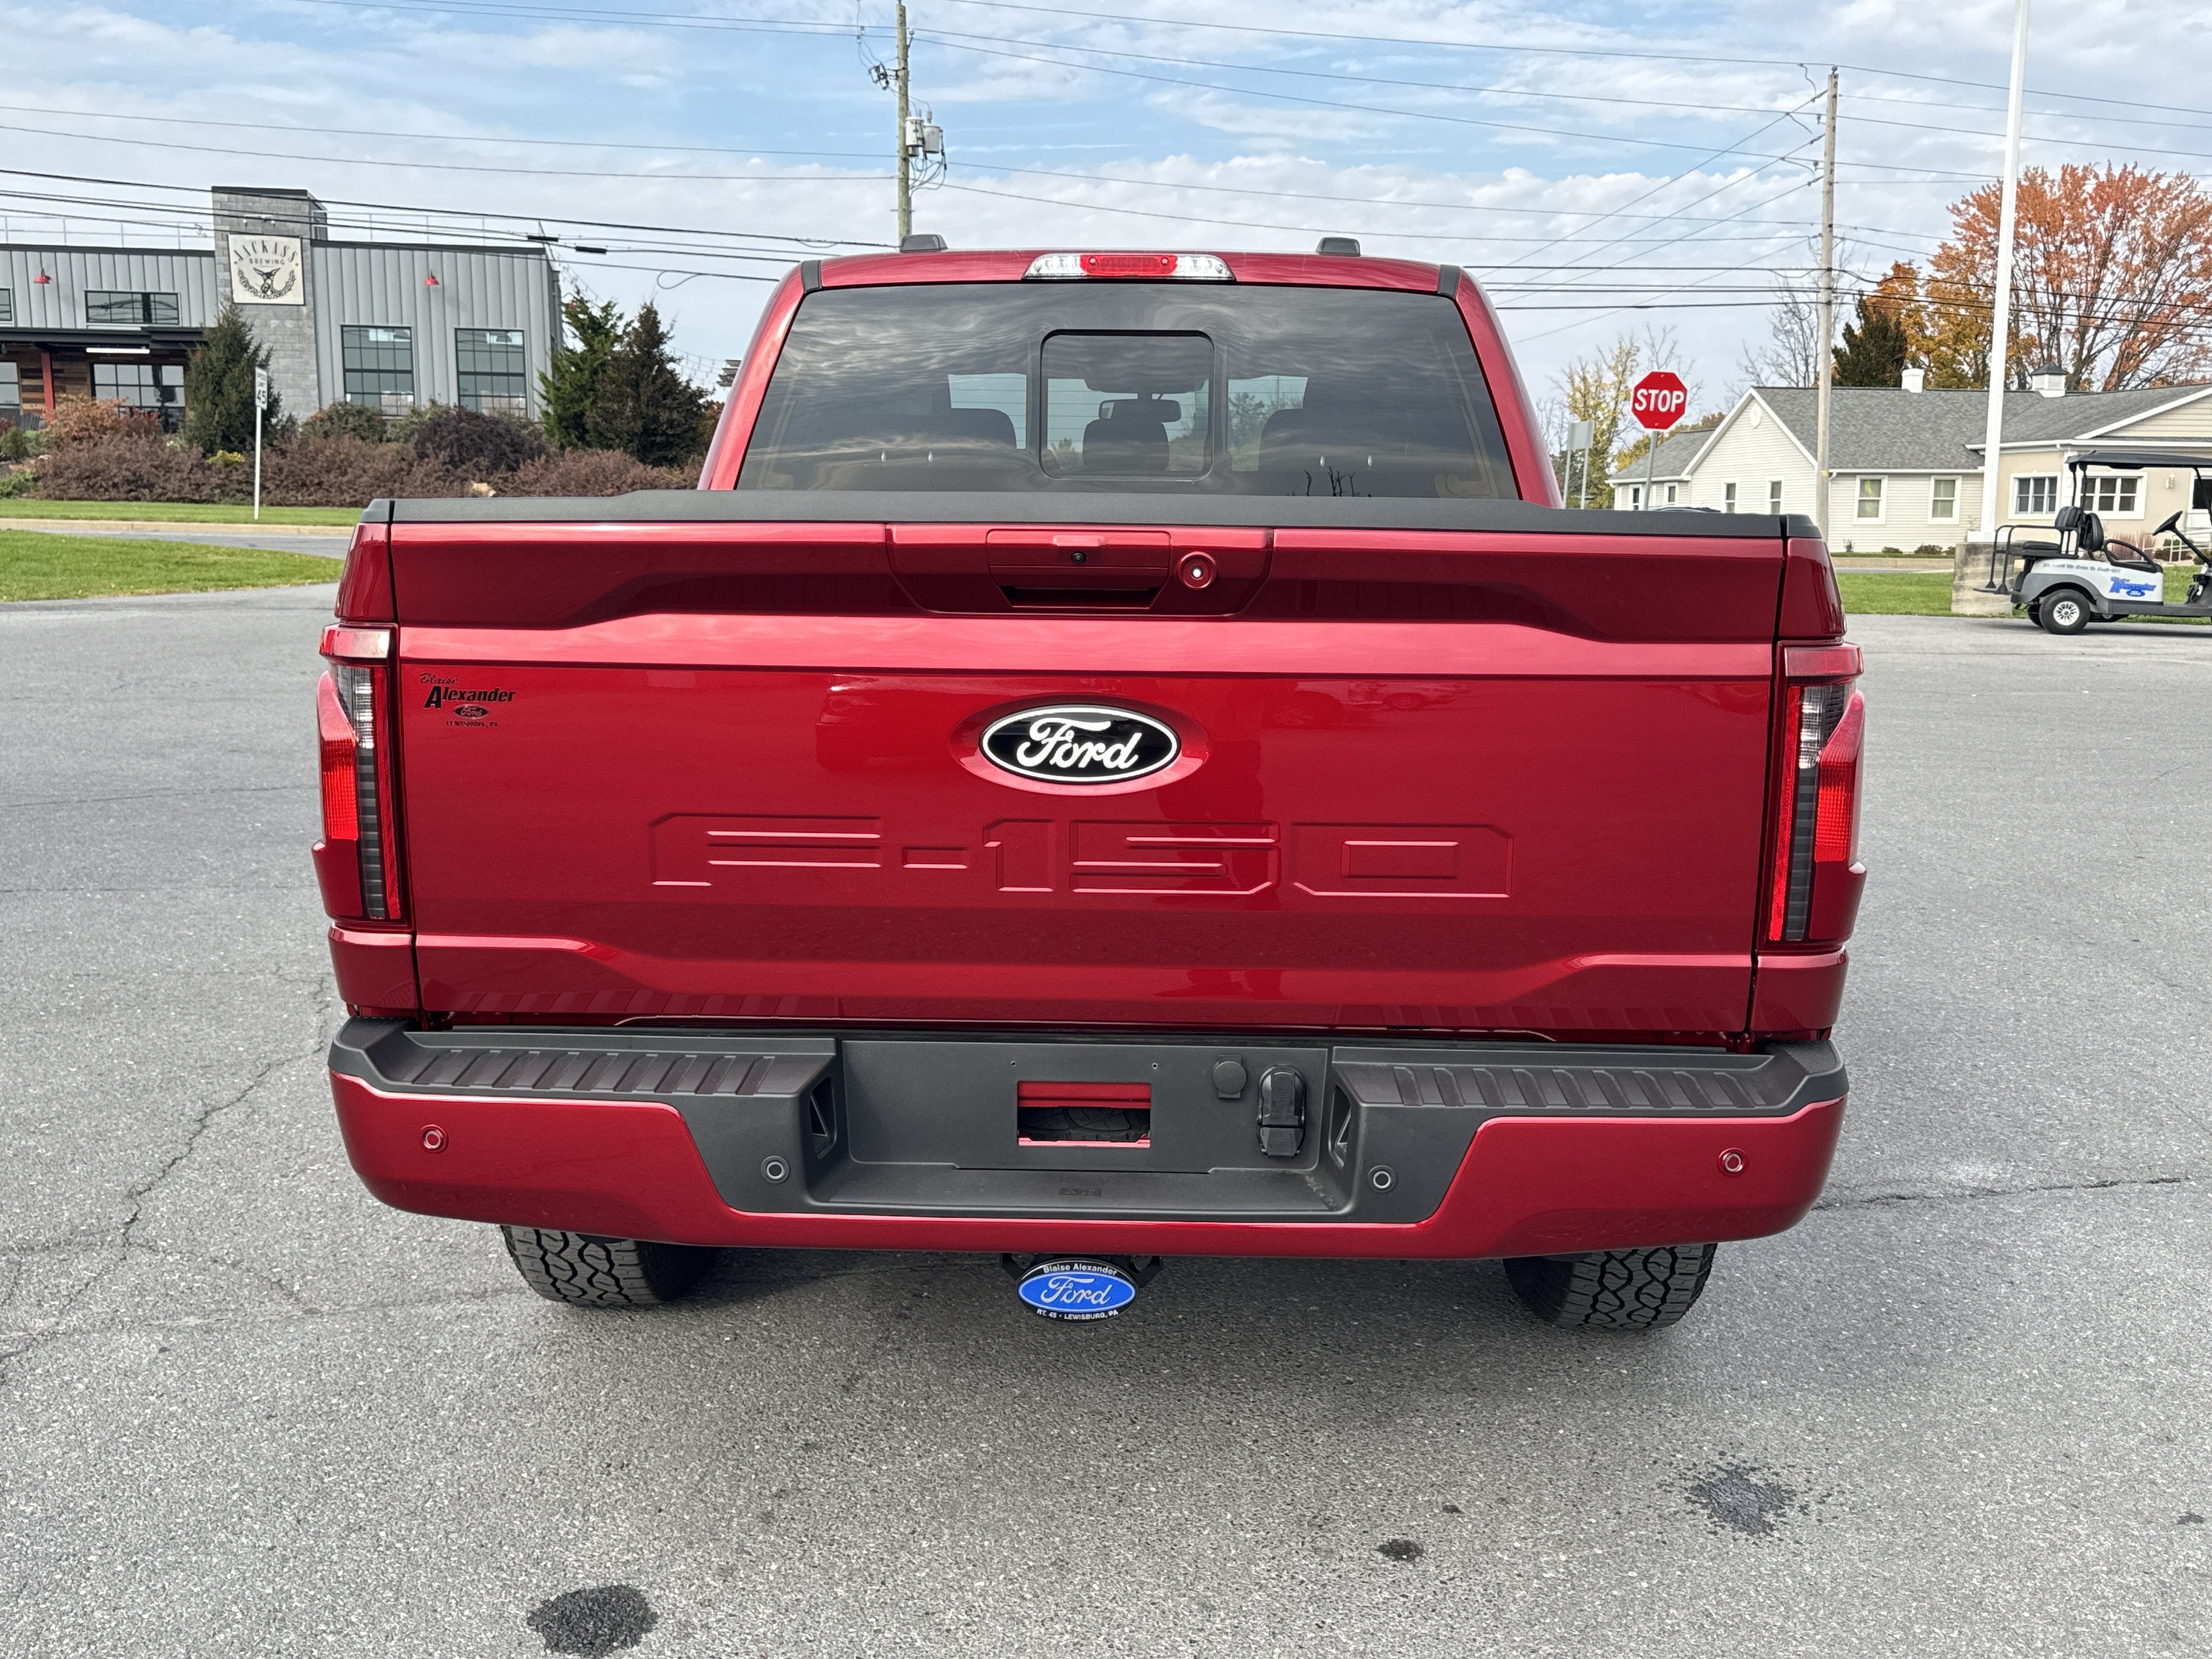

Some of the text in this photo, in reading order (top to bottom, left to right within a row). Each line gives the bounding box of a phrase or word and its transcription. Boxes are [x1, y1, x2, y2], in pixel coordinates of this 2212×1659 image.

[257, 388, 267, 404] 45
[1634, 388, 1684, 413] STOP
[423, 685, 517, 709] Alexander
[1017, 717, 1143, 769] Ford
[649, 811, 1515, 899] F-150
[1043, 1263, 1118, 1277] Blaise Alexander
[1040, 1276, 1113, 1305] Ford
